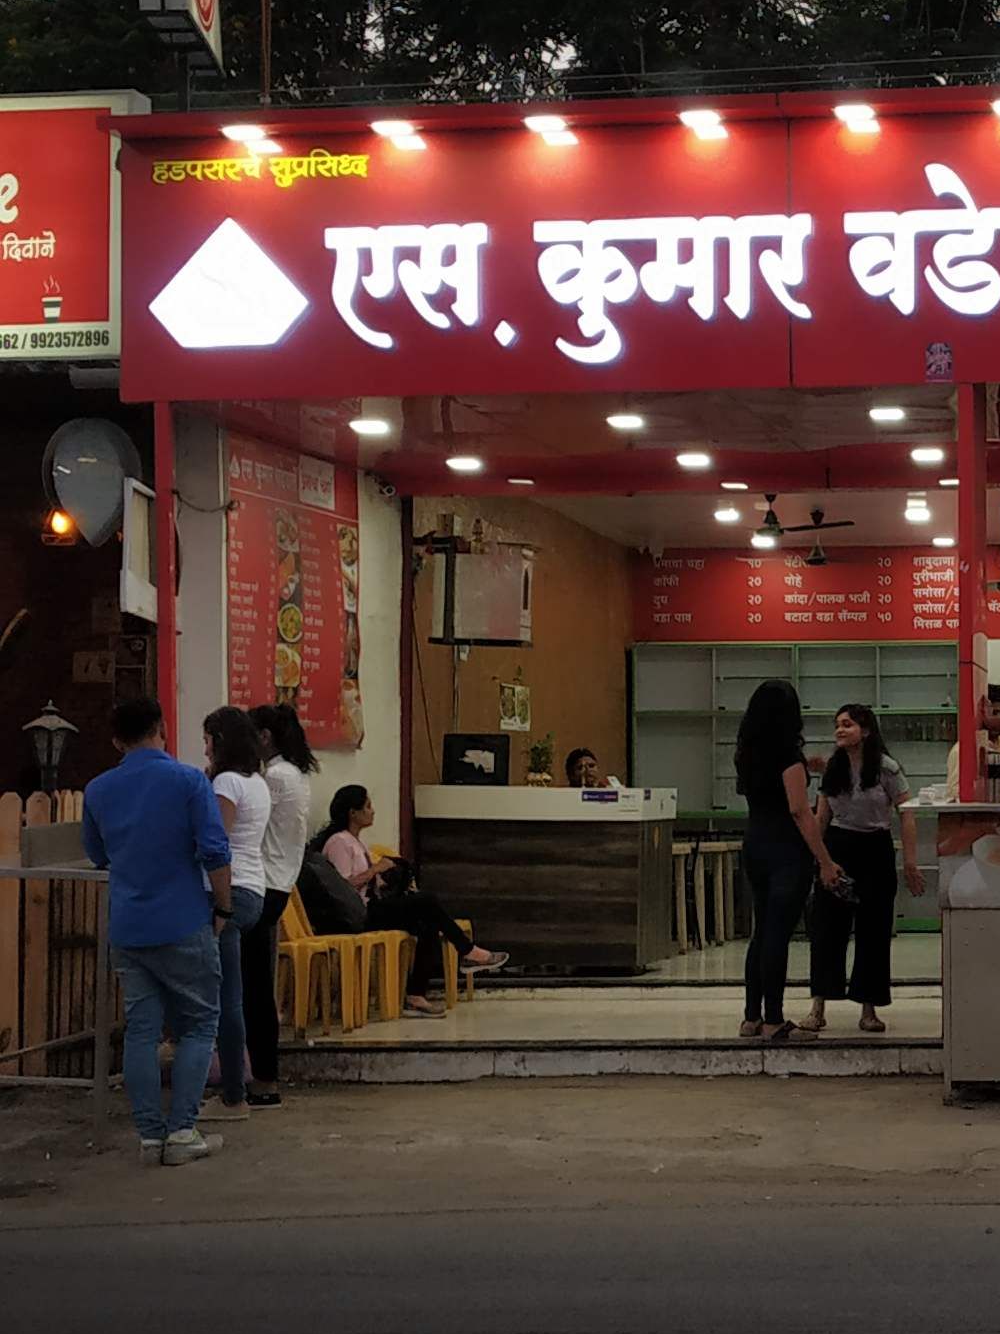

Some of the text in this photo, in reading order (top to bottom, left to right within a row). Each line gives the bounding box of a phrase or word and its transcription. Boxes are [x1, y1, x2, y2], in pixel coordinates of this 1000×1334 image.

[2, 230, 56, 261] दिवाने
[533, 216, 813, 365] कुमार
[30, 330, 109, 349] 9923572896
[877, 557, 892, 569] २०
[748, 576, 762, 587] २०
[877, 575, 892, 586] २०
[748, 594, 762, 606] २०
[877, 593, 892, 605] २०
[748, 612, 762, 623] २०
[877, 611, 892, 622] ५०
